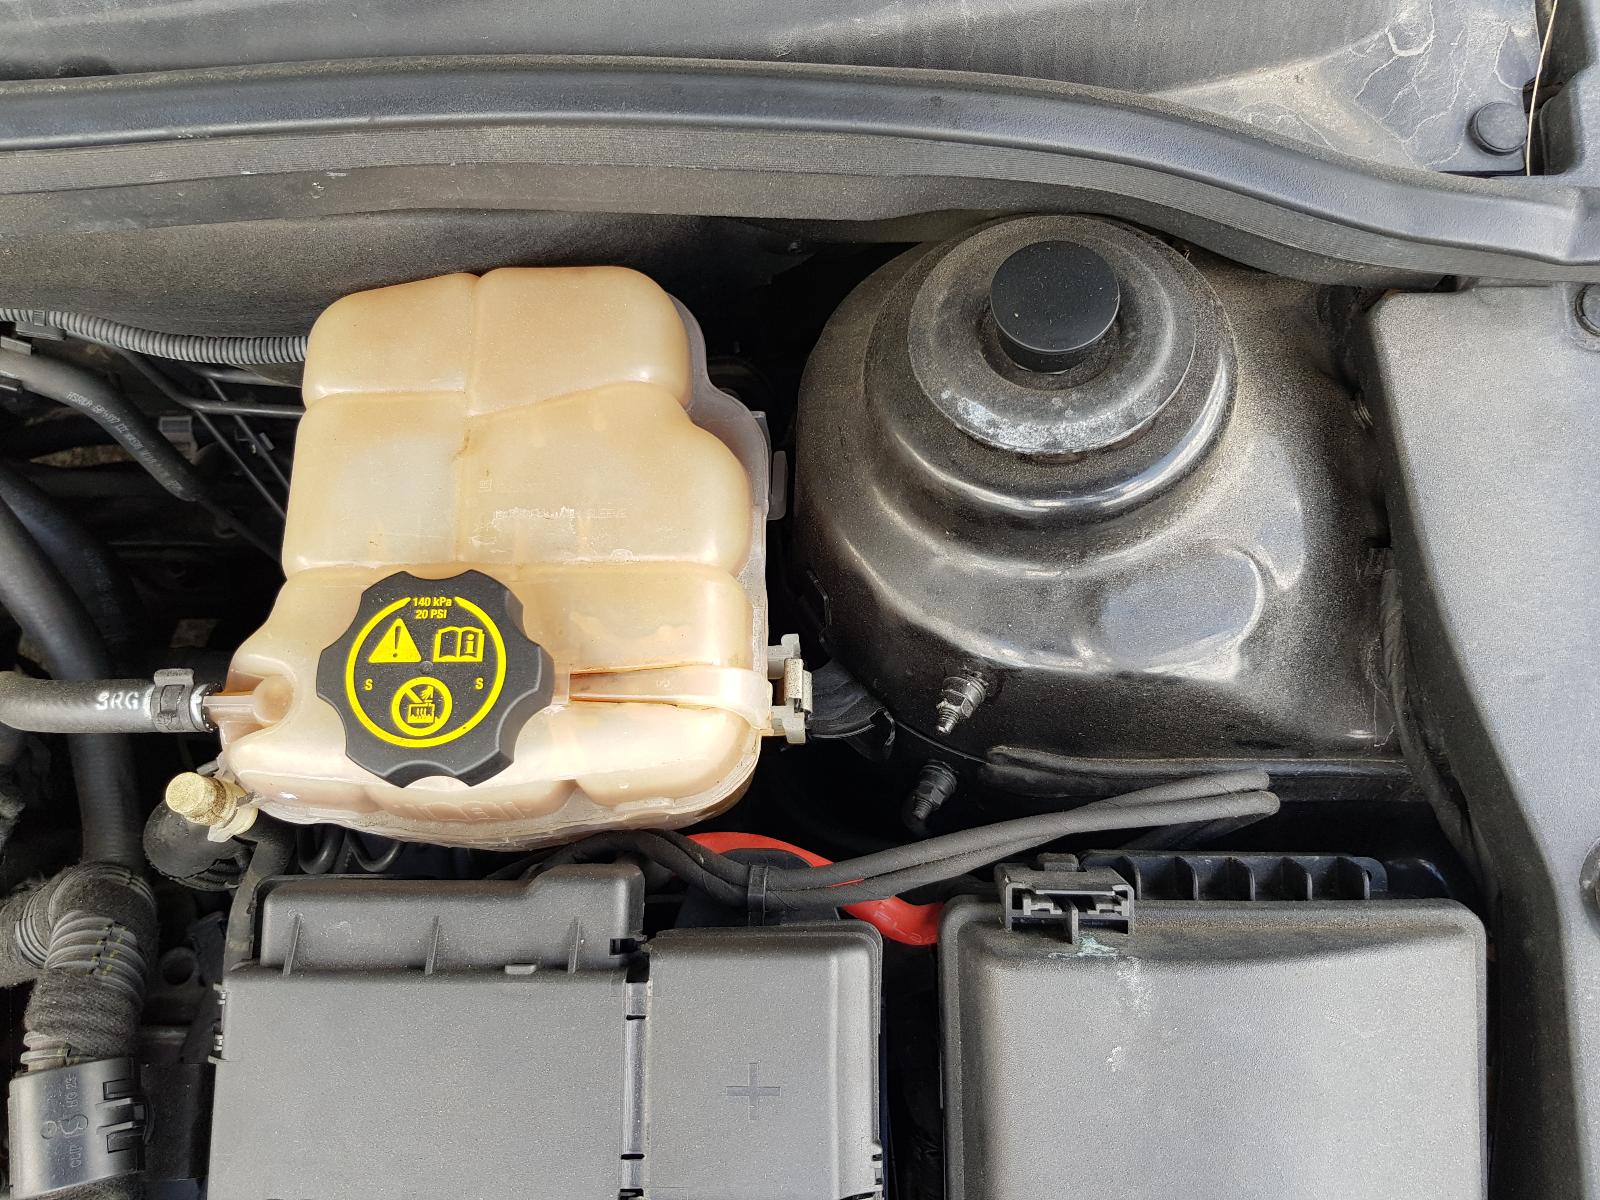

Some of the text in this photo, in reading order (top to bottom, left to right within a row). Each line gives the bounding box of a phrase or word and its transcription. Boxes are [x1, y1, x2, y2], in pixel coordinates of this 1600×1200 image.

[412, 596, 453, 607] 140 kPa
[415, 608, 448, 620] 20 PSI
[364, 678, 374, 691] S
[475, 677, 484, 690] S
